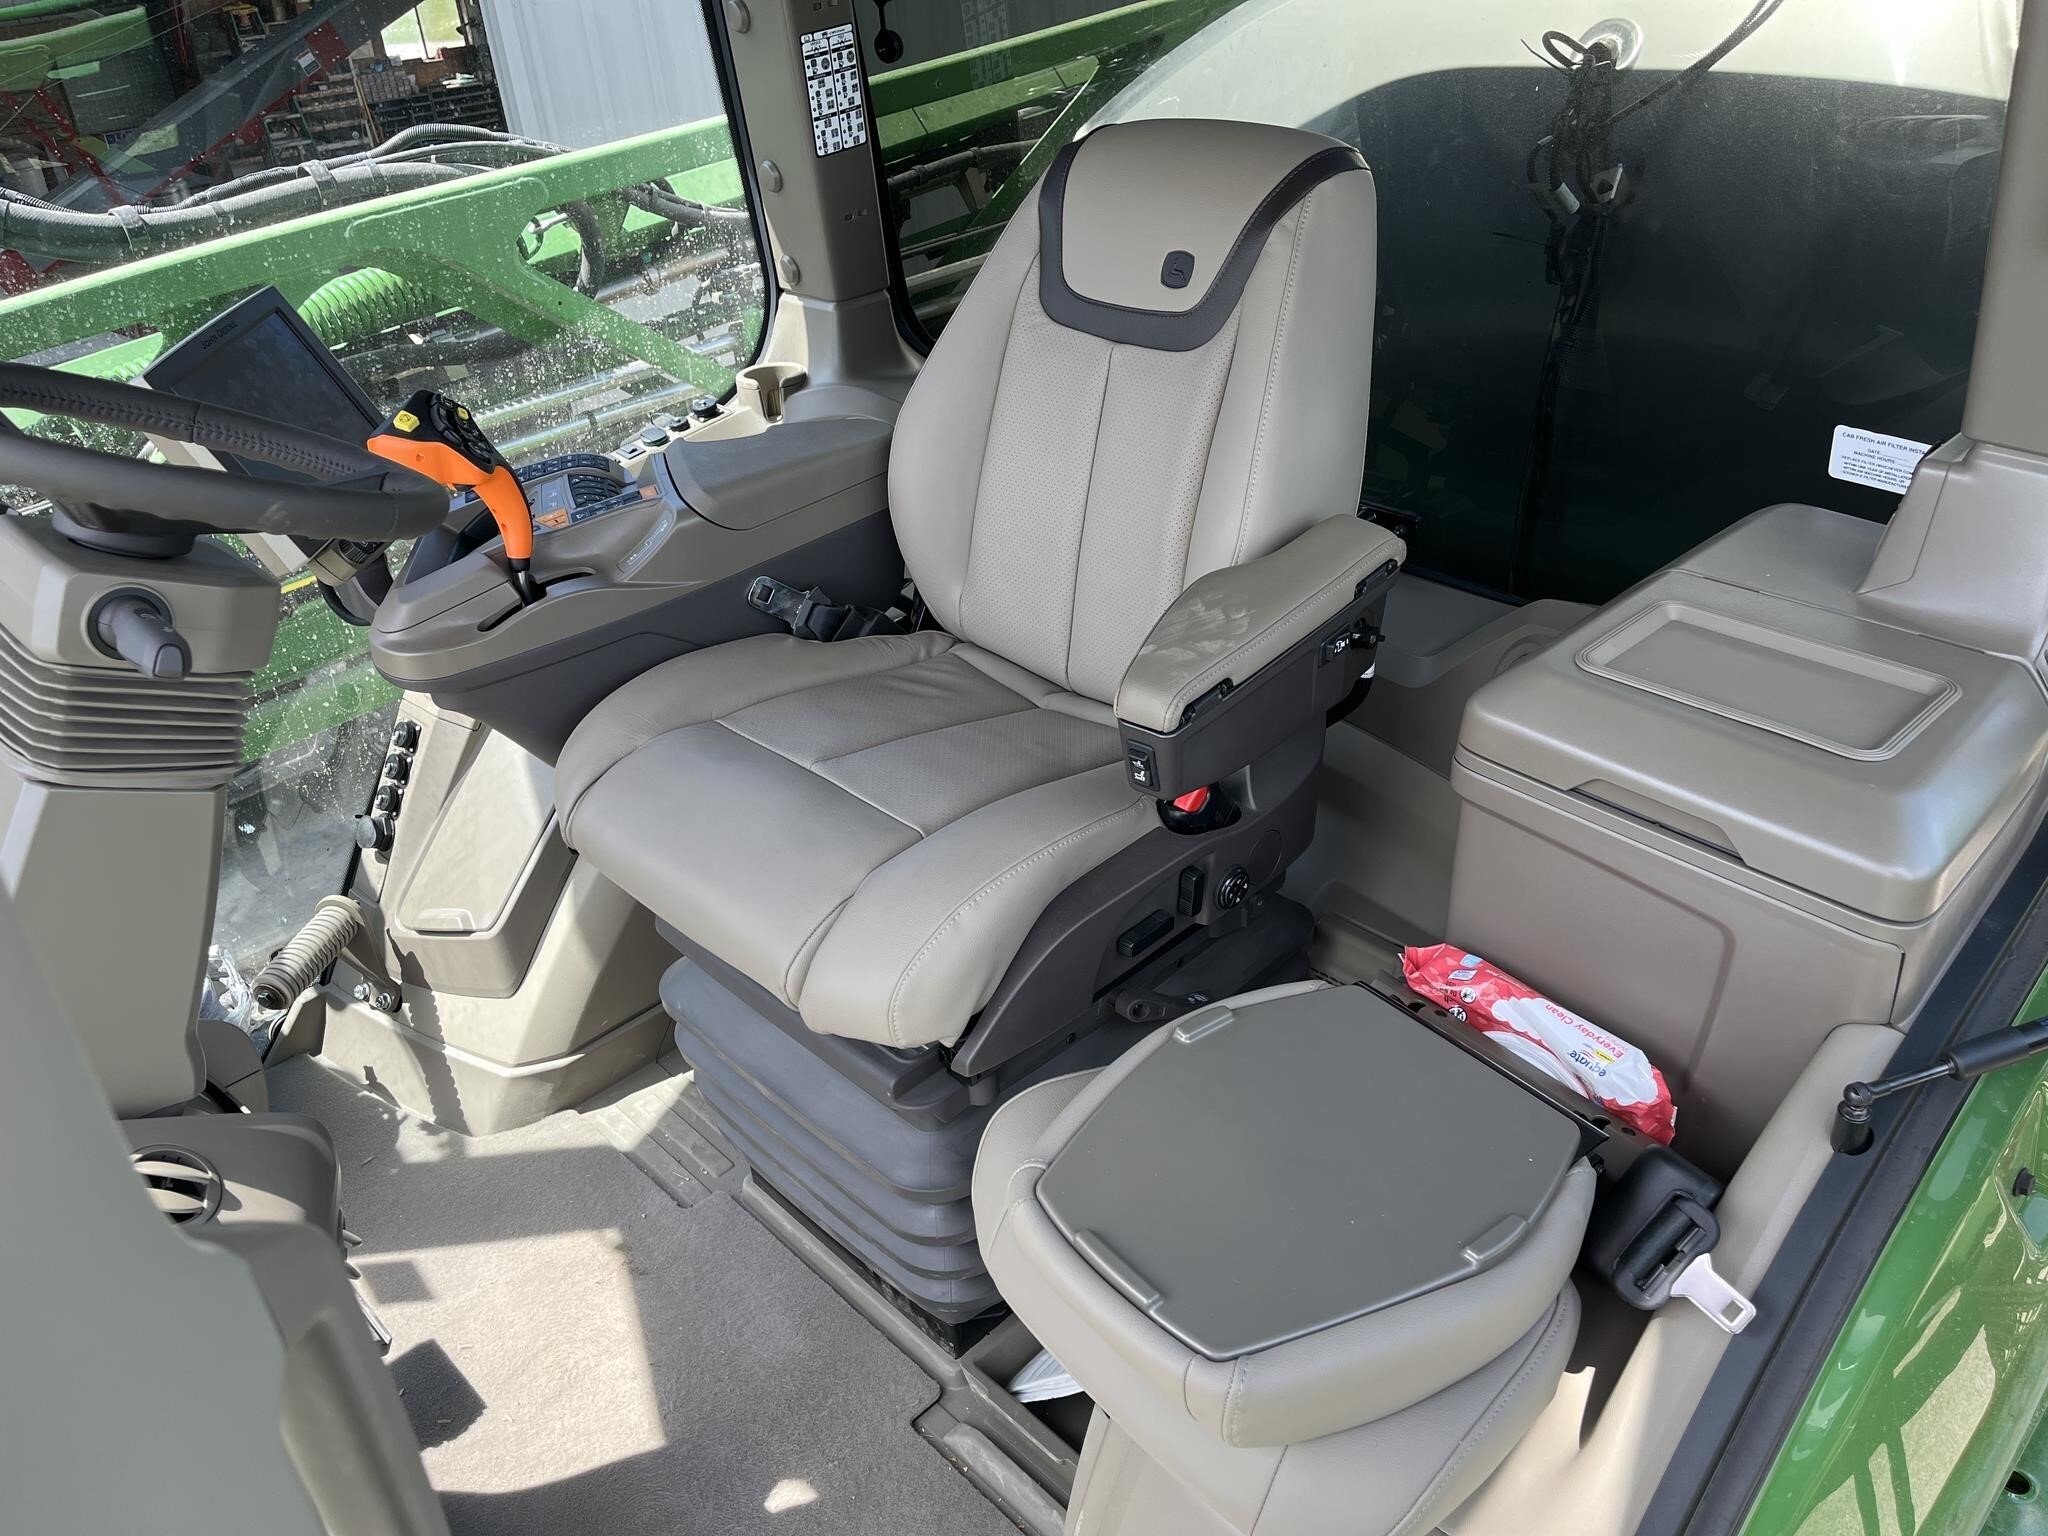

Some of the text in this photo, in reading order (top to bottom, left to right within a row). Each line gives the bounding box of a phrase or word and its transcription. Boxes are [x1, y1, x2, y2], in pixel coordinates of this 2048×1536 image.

[200, 335, 217, 350] JOHN
[1856, 434, 1875, 444] FRESH
[1888, 443, 1907, 451] FILTER
[1854, 451, 1876, 459] MACHINE
[1545, 1004, 1573, 1025] Clean
[1575, 1024, 1624, 1059] Everyday
[1569, 1050, 1607, 1077] equate
